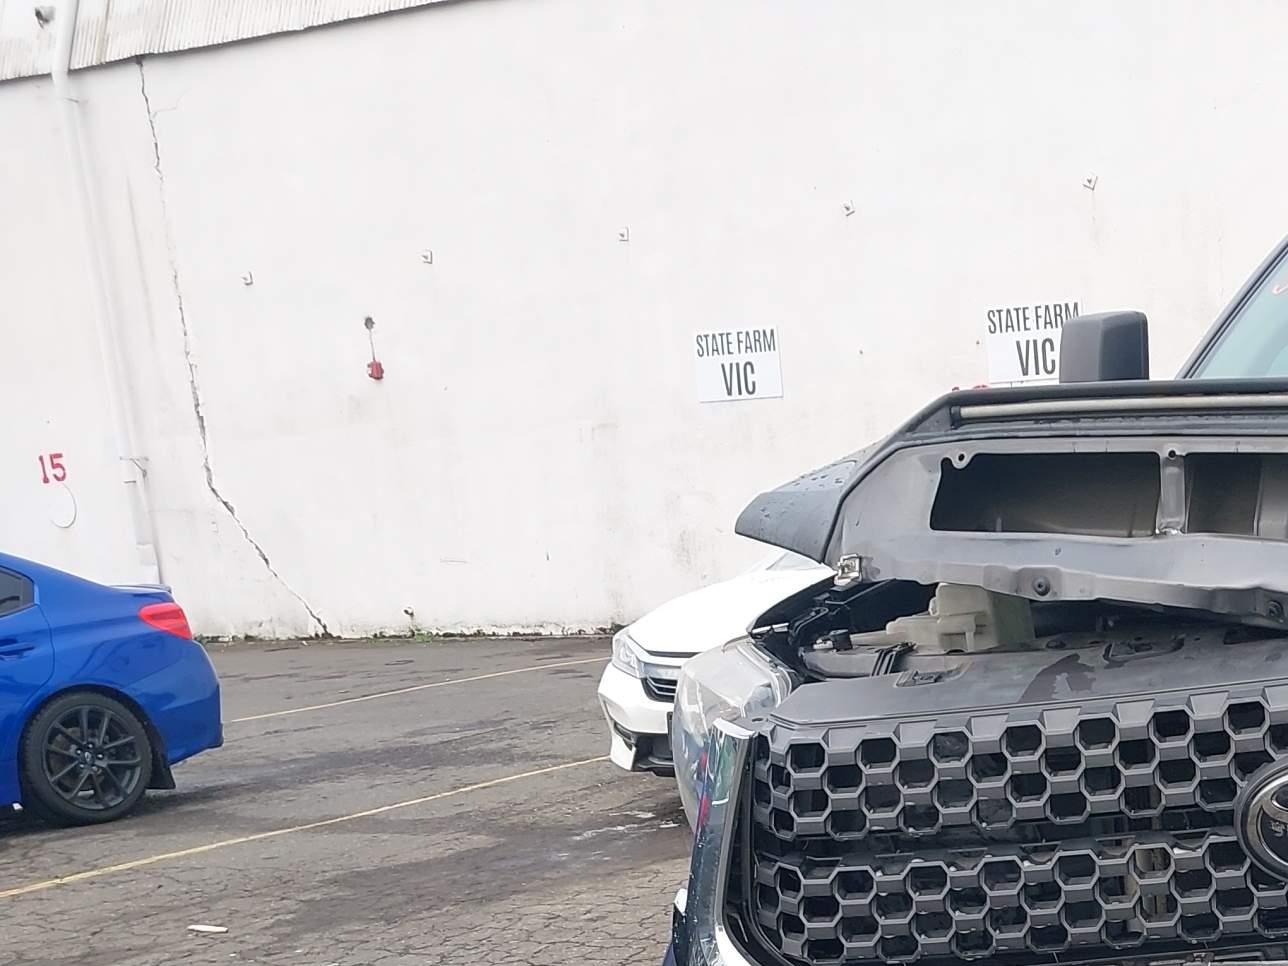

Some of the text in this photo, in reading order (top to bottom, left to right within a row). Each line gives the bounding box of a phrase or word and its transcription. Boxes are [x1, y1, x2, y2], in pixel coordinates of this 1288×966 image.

[987, 302, 1079, 334] STATE FARM
[696, 328, 776, 358] STATE FARM
[1015, 337, 1056, 377] VIC
[721, 361, 756, 396] VIC
[38, 452, 67, 484] 15
